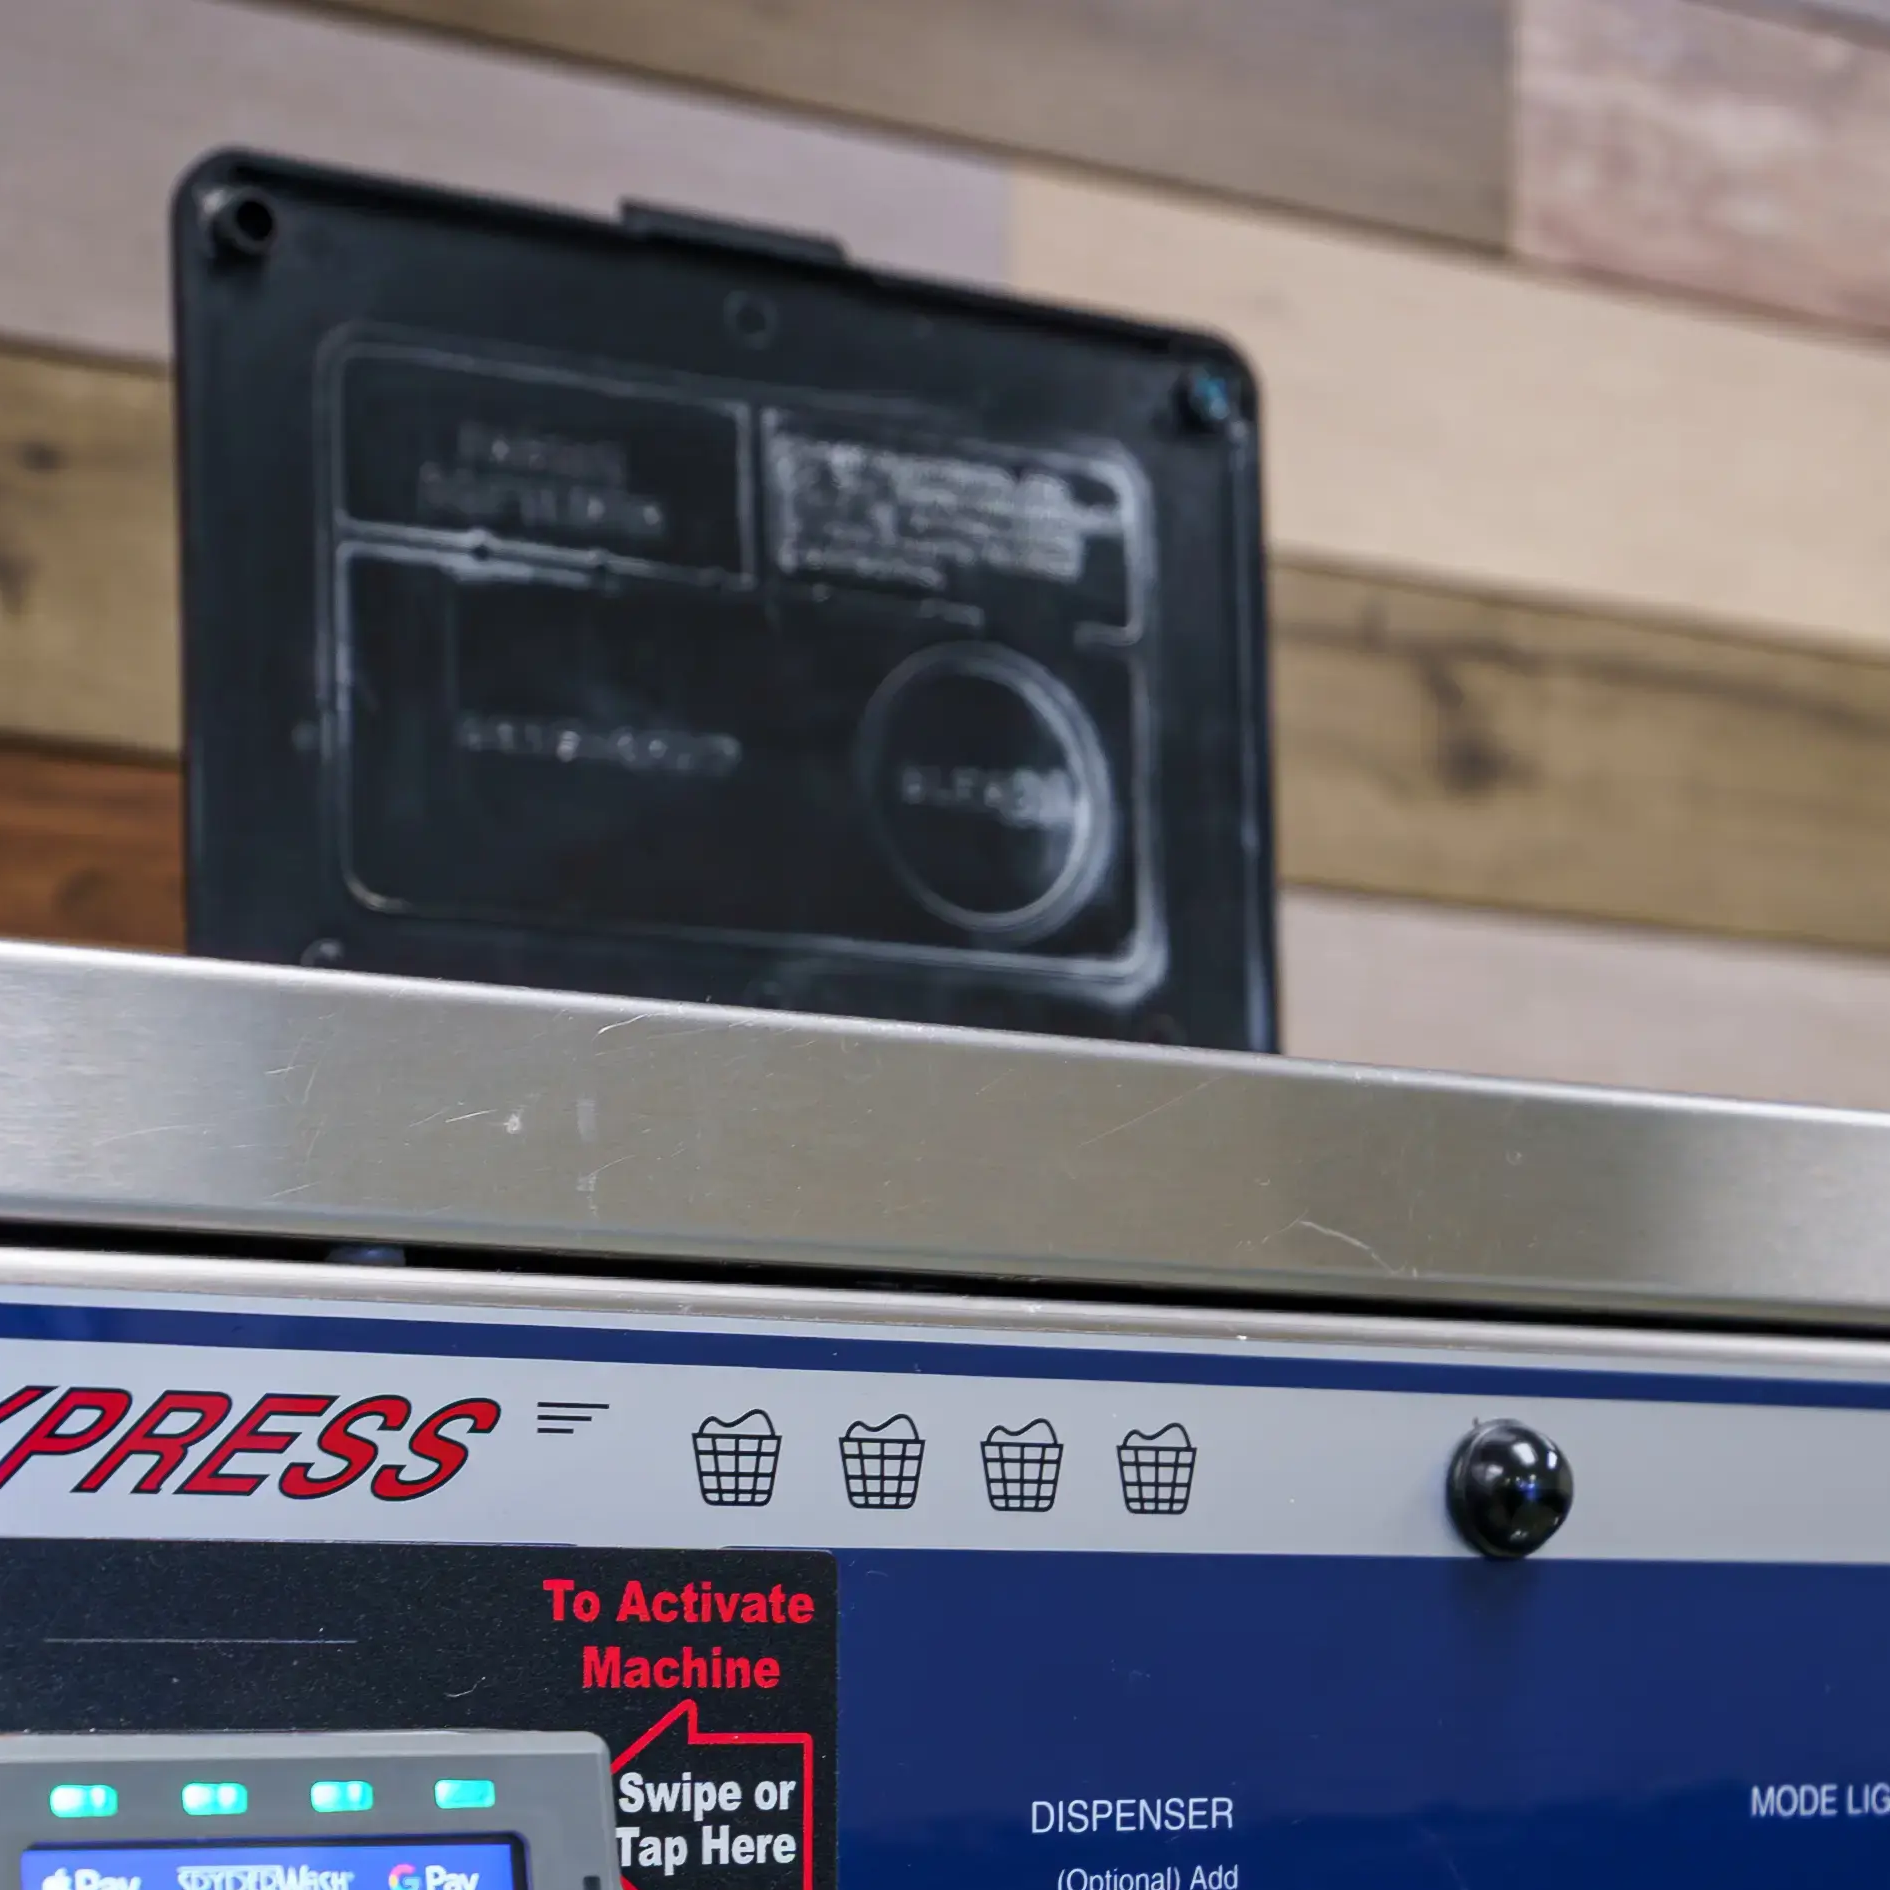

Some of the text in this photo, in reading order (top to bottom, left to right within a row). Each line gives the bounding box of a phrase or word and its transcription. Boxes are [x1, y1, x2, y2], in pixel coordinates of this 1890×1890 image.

[543, 1579, 814, 1623] To Activate
[582, 1646, 780, 1688] Machine
[618, 1772, 797, 1822] Swipe or
[1031, 1797, 1234, 1834] DISPENSER
[1750, 1784, 1838, 1818] MODE
[615, 1825, 797, 1876] Tap Here
[1189, 1864, 1239, 1890] Add
